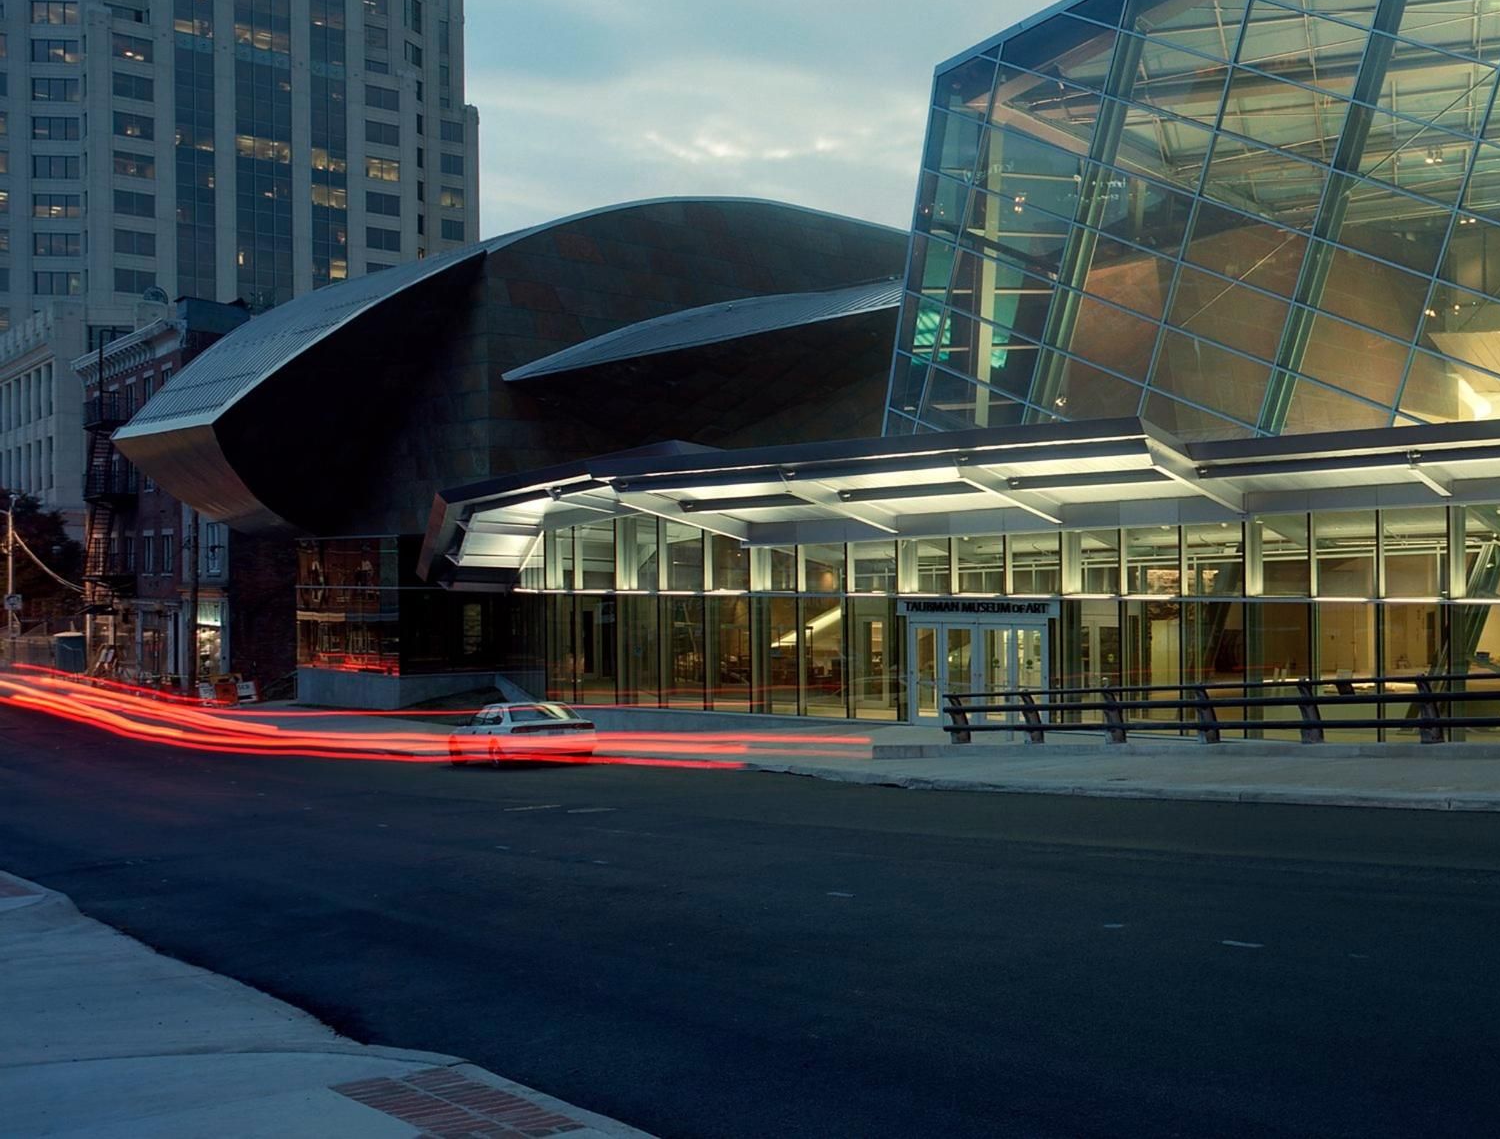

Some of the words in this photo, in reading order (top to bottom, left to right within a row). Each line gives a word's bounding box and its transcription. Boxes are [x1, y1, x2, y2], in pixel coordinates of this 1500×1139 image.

[904, 601, 960, 612] TAUBMAN
[962, 602, 1011, 613] MUSEUM
[1027, 602, 1049, 614] ART
